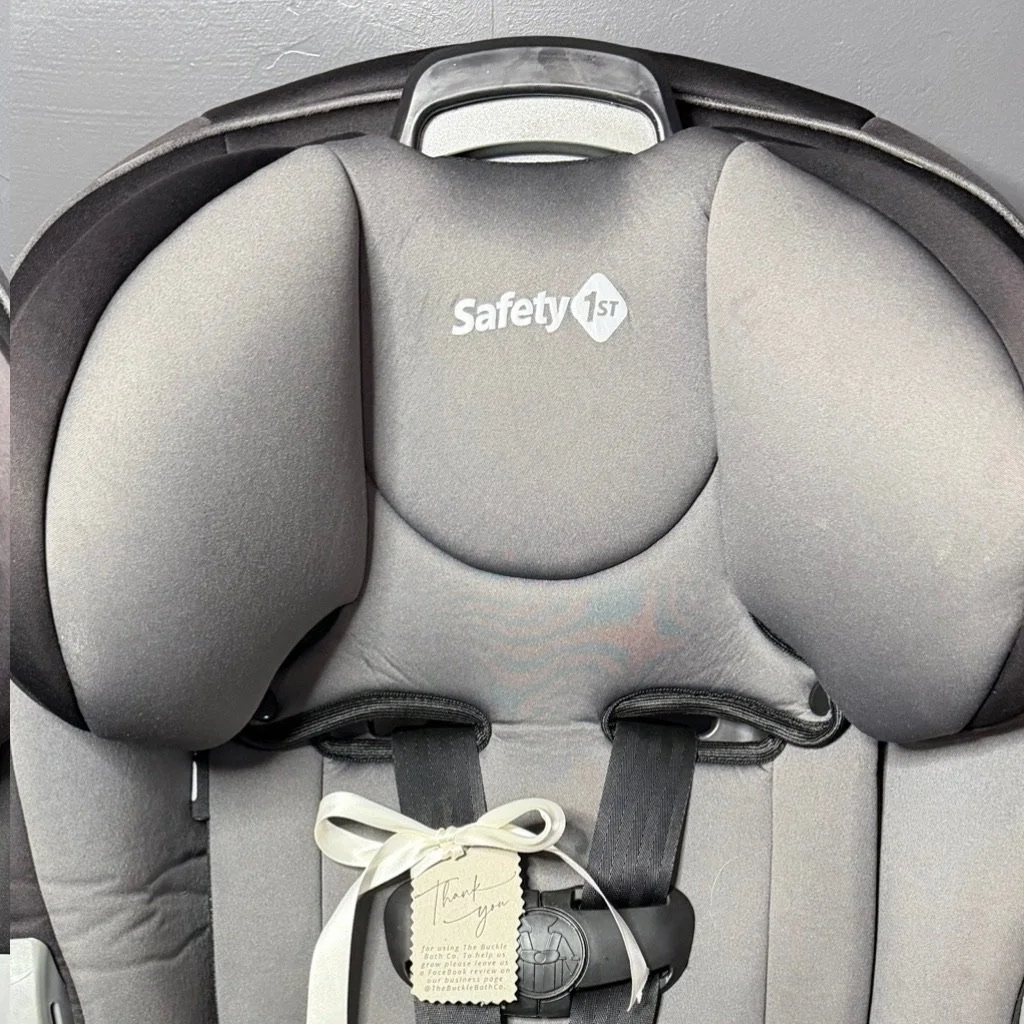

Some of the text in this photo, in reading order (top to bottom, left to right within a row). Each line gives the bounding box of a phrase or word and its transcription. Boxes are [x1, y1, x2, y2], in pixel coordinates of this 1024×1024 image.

[451, 290, 620, 335] Safety 1ST
[414, 871, 517, 925] Thank
[443, 900, 510, 938] you
[421, 945, 434, 953] for
[437, 944, 459, 952] using
[483, 976, 503, 984] page
